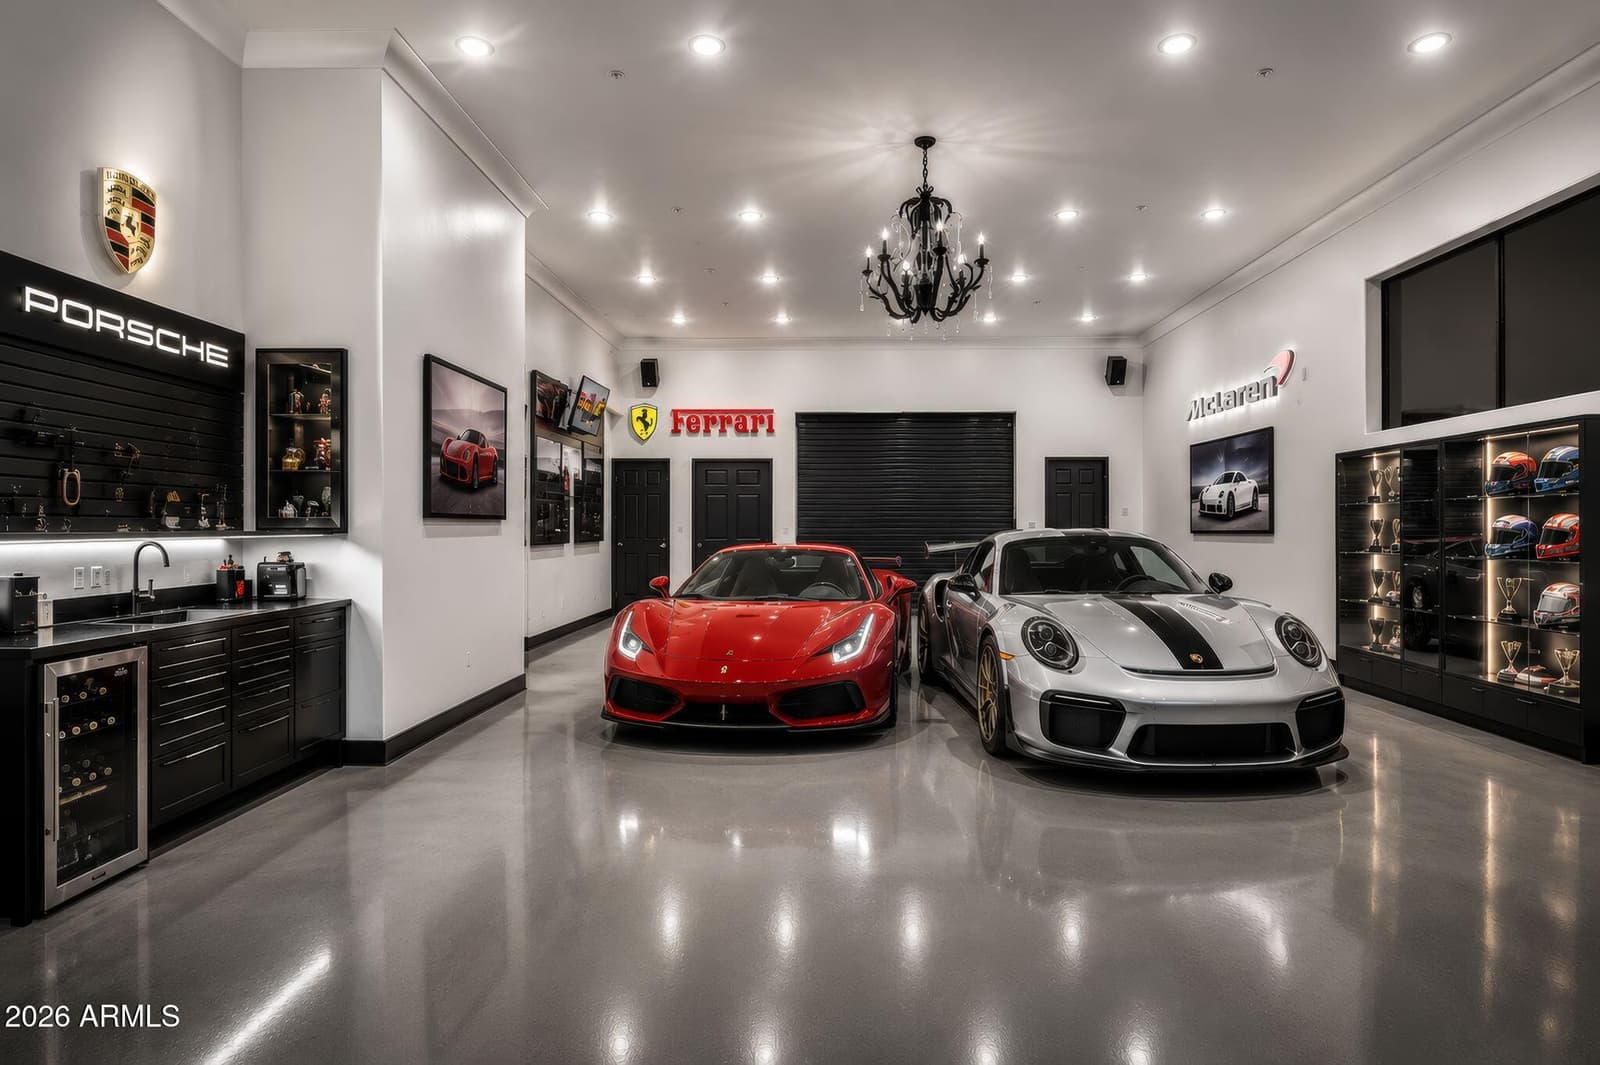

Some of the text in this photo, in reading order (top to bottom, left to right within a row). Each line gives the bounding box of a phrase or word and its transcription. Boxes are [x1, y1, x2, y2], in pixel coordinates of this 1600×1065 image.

[25, 286, 228, 368] PORSCHE
[1185, 375, 1278, 421] McLaren
[671, 409, 775, 434] Ferrari
